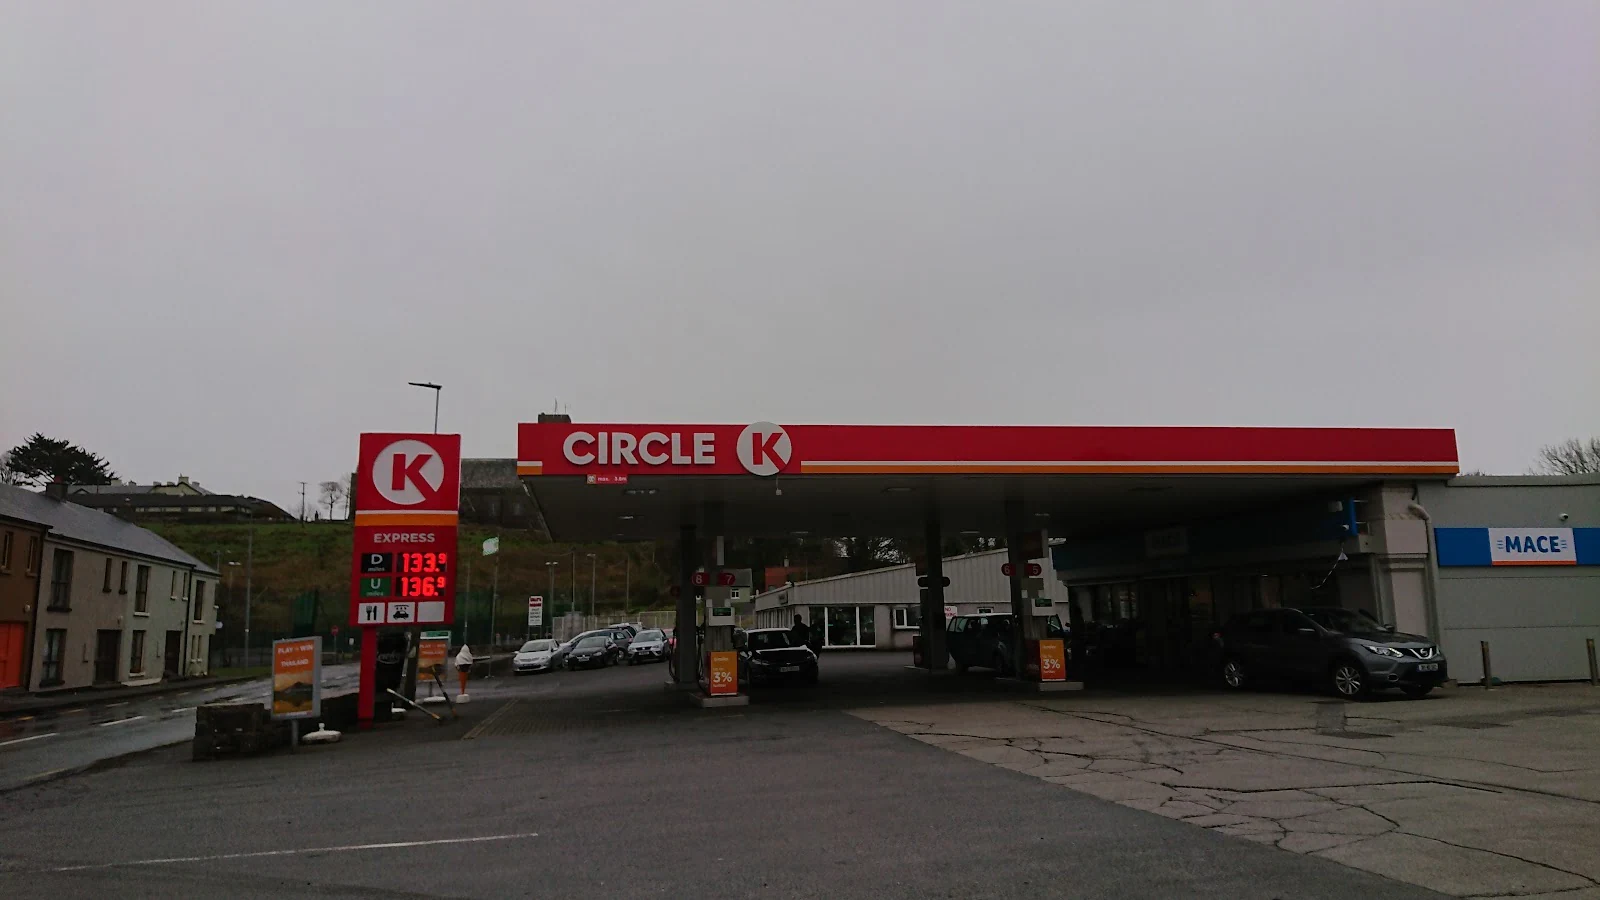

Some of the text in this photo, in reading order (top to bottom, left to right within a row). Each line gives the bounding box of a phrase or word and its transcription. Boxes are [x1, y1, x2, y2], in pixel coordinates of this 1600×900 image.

[562, 431, 787, 472] CIRCLE K
[391, 453, 437, 500] K
[373, 532, 436, 544] EXPRESS
[1505, 535, 1561, 553] MACE
[370, 553, 383, 565] D
[1004, 564, 1011, 575] 6
[1032, 564, 1039, 575] 5
[370, 577, 381, 590] U
[695, 574, 703, 585] 8
[725, 574, 733, 585] 7
[277, 647, 293, 655] PLAY
[1043, 658, 1061, 670] 3%
[712, 671, 733, 683] 3%
